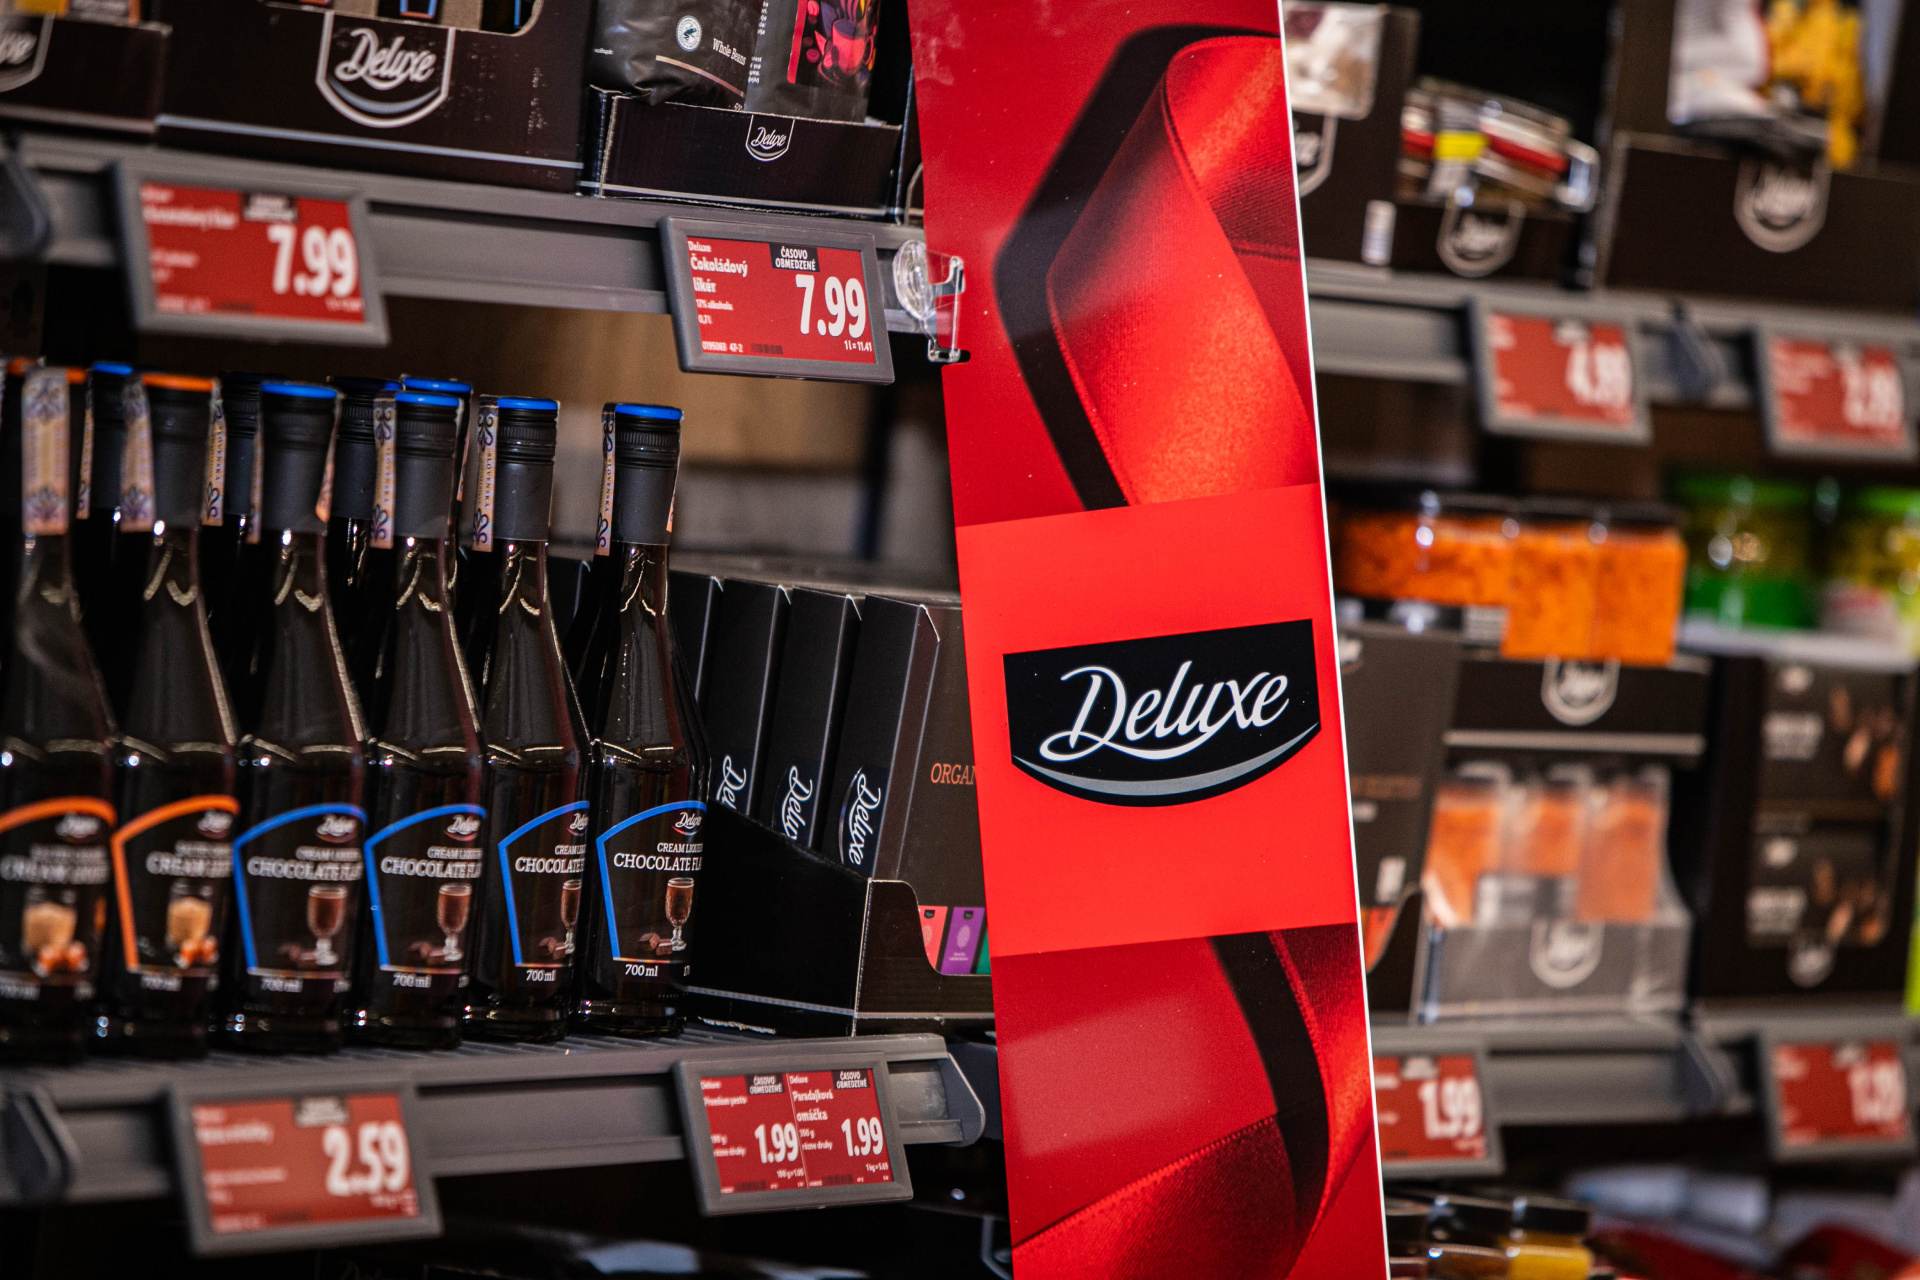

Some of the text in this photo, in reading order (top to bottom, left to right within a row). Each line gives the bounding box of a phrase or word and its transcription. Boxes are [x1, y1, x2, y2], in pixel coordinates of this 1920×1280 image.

[335, 27, 437, 91] Deluxe
[713, 37, 747, 66] Whole Beans
[750, 126, 787, 150] Deluxe
[266, 223, 359, 297] 7.99
[774, 257, 817, 271] OBMEDZENÉ
[780, 245, 808, 260] ČASOVO
[690, 252, 749, 278] Čokoládový
[795, 273, 867, 338] 7.99
[1039, 660, 1290, 762] Deluxe
[848, 773, 881, 866] Deluxe
[657, 842, 685, 853] CREAM
[381, 856, 466, 878] CHOCOLATE
[613, 852, 691, 871] CHOCOLATE
[392, 972, 432, 988] 700 ml
[526, 969, 556, 982] 700 ml
[625, 964, 660, 977] 700 ml
[839, 1070, 861, 1080] ČASOVO
[792, 1089, 834, 1103] Paradajková
[796, 1108, 828, 1122] omáčka
[754, 1122, 799, 1164] 1.99
[841, 1116, 884, 1157] 1.99
[322, 1119, 411, 1197] 2.59
